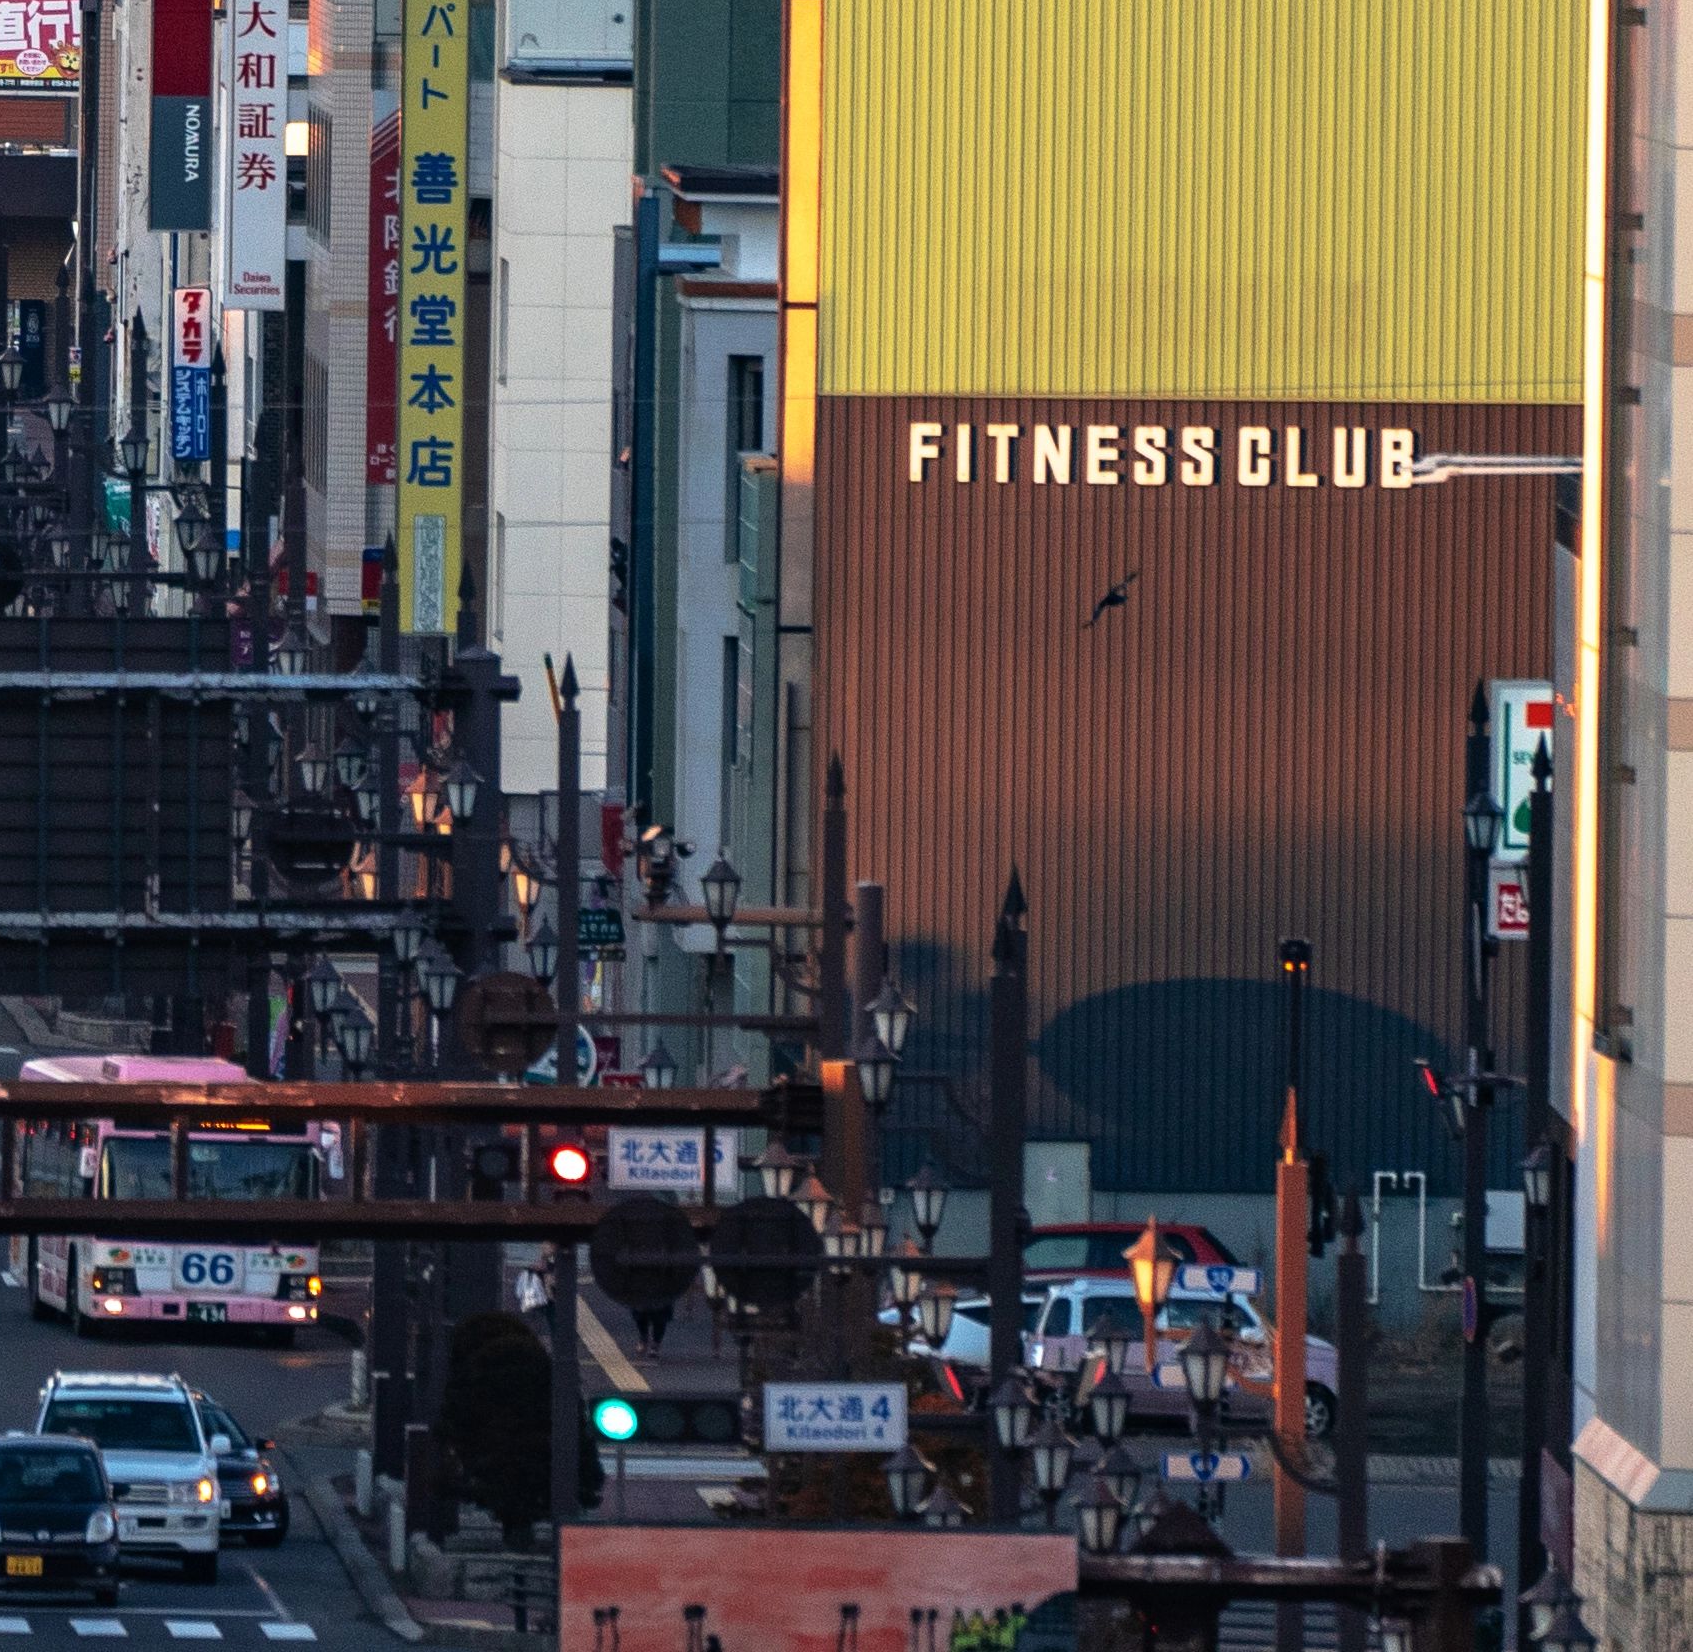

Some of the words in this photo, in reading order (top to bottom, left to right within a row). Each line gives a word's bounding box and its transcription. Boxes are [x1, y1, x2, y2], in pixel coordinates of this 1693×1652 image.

[236, 1, 277, 192] 大和証券
[183, 103, 201, 183] NOMURA
[233, 283, 281, 297] Securities
[242, 271, 272, 284] Daiwa
[182, 291, 204, 364] タカラ
[407, 151, 459, 488] 善光堂本店
[908, 422, 1215, 487] FITNESS
[1236, 426, 1418, 489] CLUB
[181, 1252, 235, 1285] 66
[777, 1395, 892, 1423] 北大通4
